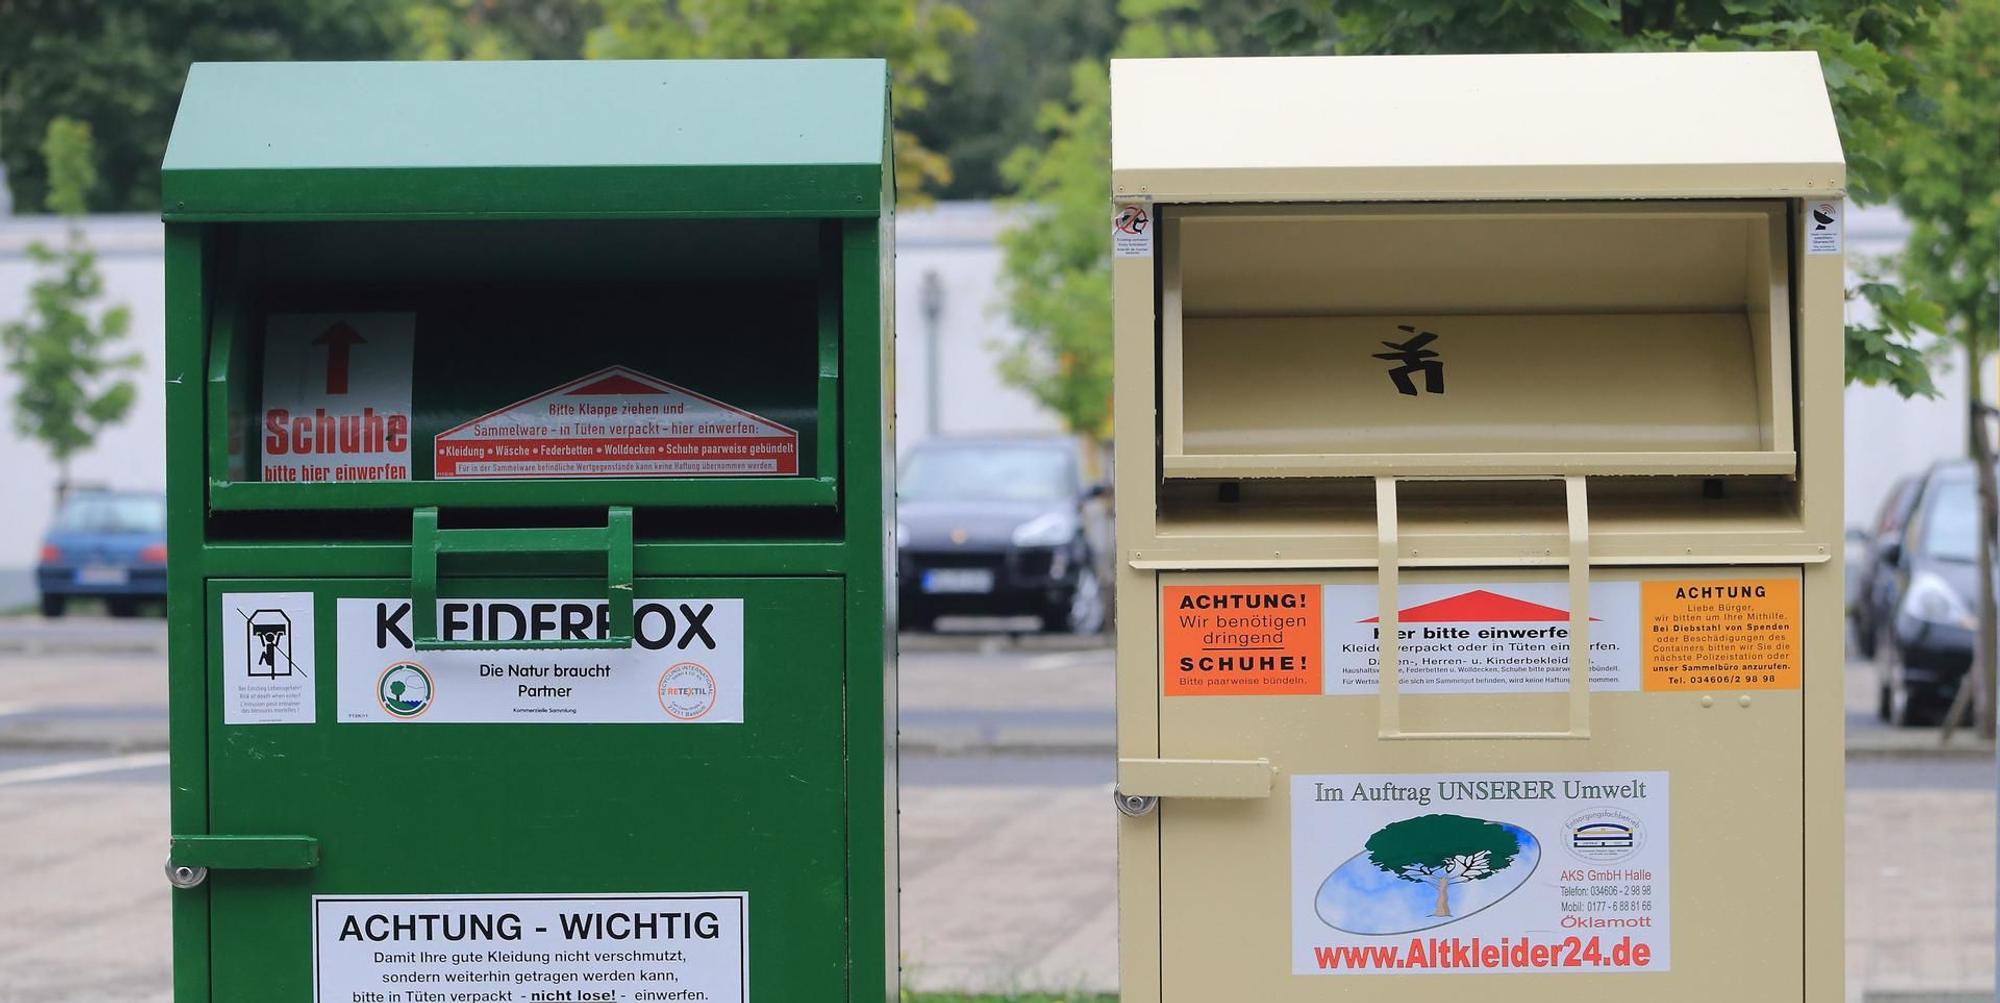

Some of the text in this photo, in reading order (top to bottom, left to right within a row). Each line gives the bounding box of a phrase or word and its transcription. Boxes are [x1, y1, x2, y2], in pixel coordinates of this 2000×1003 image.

[550, 403, 684, 418] Bitte Klappe ziehen und
[266, 408, 408, 455] Schuhe
[474, 424, 547, 437] Sammelware
[560, 424, 570, 435] in
[576, 422, 607, 435] Tüten
[610, 423, 660, 436] verpackt
[672, 422, 693, 434] hier
[699, 422, 759, 434] einwerfen:
[446, 443, 793, 458] Kleidung Wäsche Federbetten Wolldecken Schuhe paarweise gebündelt
[265, 463, 406, 482] bitte hier einwerfen
[1676, 586, 1766, 600] ACHTUNG
[1180, 594, 1306, 610] ACHTUNG!
[1688, 604, 1714, 612] Liebe
[1180, 614, 1306, 630] Wir benötigen
[1654, 614, 1668, 622] wir
[1673, 614, 1702, 622] bitten
[376, 602, 716, 650] KEIDEROX
[1424, 626, 1569, 639] bitte einwerfe
[1726, 624, 1742, 632] von
[1747, 624, 1790, 632] Spenden
[1203, 632, 1284, 646] dringend
[1657, 634, 1786, 645] oder Beschädigungen des
[1458, 644, 1488, 652] oder
[1492, 643, 1504, 651] in
[1509, 642, 1546, 651] Tüten
[1550, 642, 1620, 651] einrfen.
[1653, 645, 1704, 653] Containers
[1708, 644, 1736, 652] bitten
[1758, 643, 1772, 651] Sie
[1776, 643, 1790, 651] die
[1654, 652, 1789, 661] nächste Polizeistation oder
[480, 664, 611, 678] Die Natur braucht
[1180, 656, 1306, 672] SCHUHE!
[1180, 677, 1308, 690] Bitte paarweise bündeln.
[518, 684, 572, 698] Partner
[667, 688, 707, 696] RETEXTIL
[1314, 779, 1647, 806] Im Auftrag UNSERER Umwelt
[1560, 870, 1652, 881] AKS GmbH Halle
[1560, 886, 1651, 896] Telefon: 034606 2 98 98
[1561, 902, 1584, 912] Mobil:
[1588, 902, 1606, 911] 0177
[1620, 901, 1628, 911] 88
[1631, 901, 1640, 911] 81
[1642, 901, 1652, 911] 66
[339, 913, 522, 941] ACHTUNG
[560, 912, 720, 940] WICHTIG
[1560, 915, 1652, 928] Öklamott
[374, 950, 686, 965] Damit Ihre gute Kleidung nicht verschmutzt,
[1314, 936, 1652, 969] www.Altkleider24.de
[382, 970, 679, 984] sondern weiterhin getragen werden kann,
[352, 991, 384, 1003] bitte
[389, 991, 400, 1002] in
[406, 990, 445, 1002] Tüten
[450, 990, 512, 1003] verpackt
[532, 990, 572, 1001] nicht
[578, 990, 616, 1001] lose!
[634, 989, 708, 1001] einwerfen.
